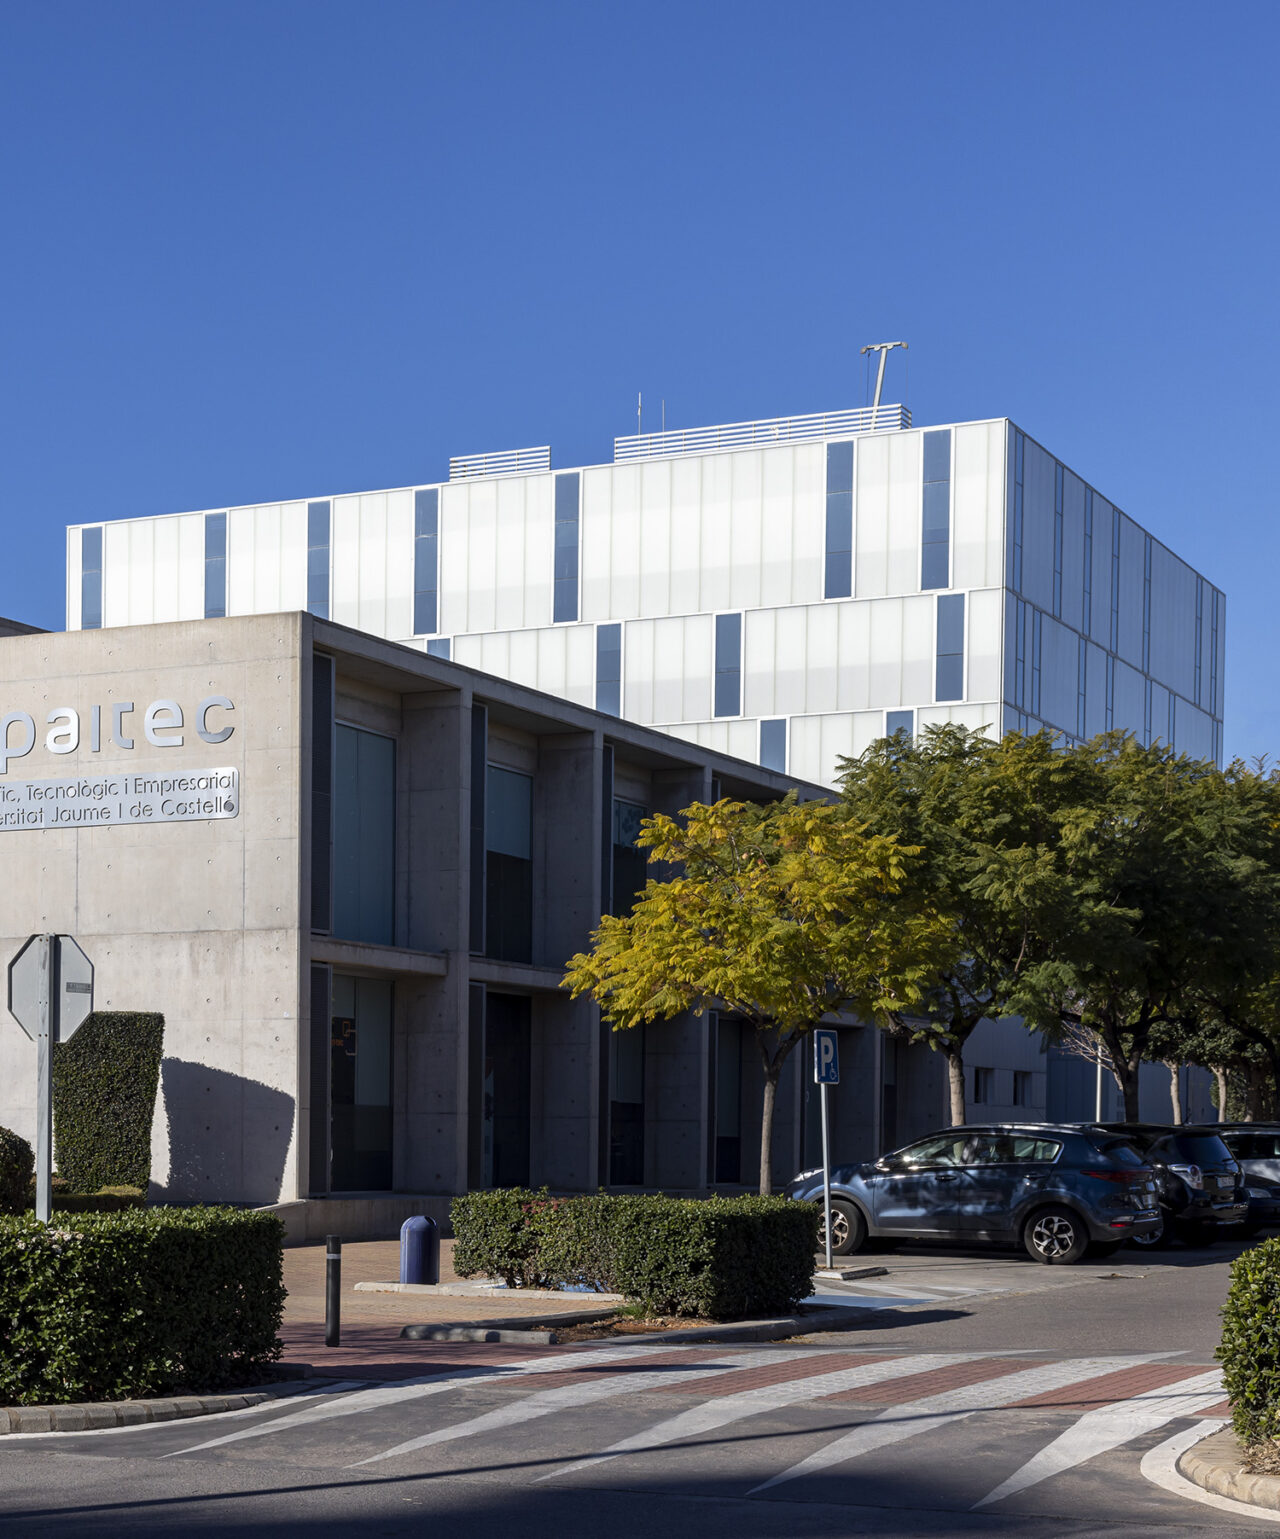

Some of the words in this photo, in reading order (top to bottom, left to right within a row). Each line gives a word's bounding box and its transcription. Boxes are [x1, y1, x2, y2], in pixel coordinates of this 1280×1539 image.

[26, 779, 119, 801] Tecnològic
[134, 771, 235, 797] Empresarial
[51, 806, 111, 823] Jaume
[129, 801, 153, 818] de
[161, 794, 236, 816] Castelló
[820, 1036, 834, 1077] P
